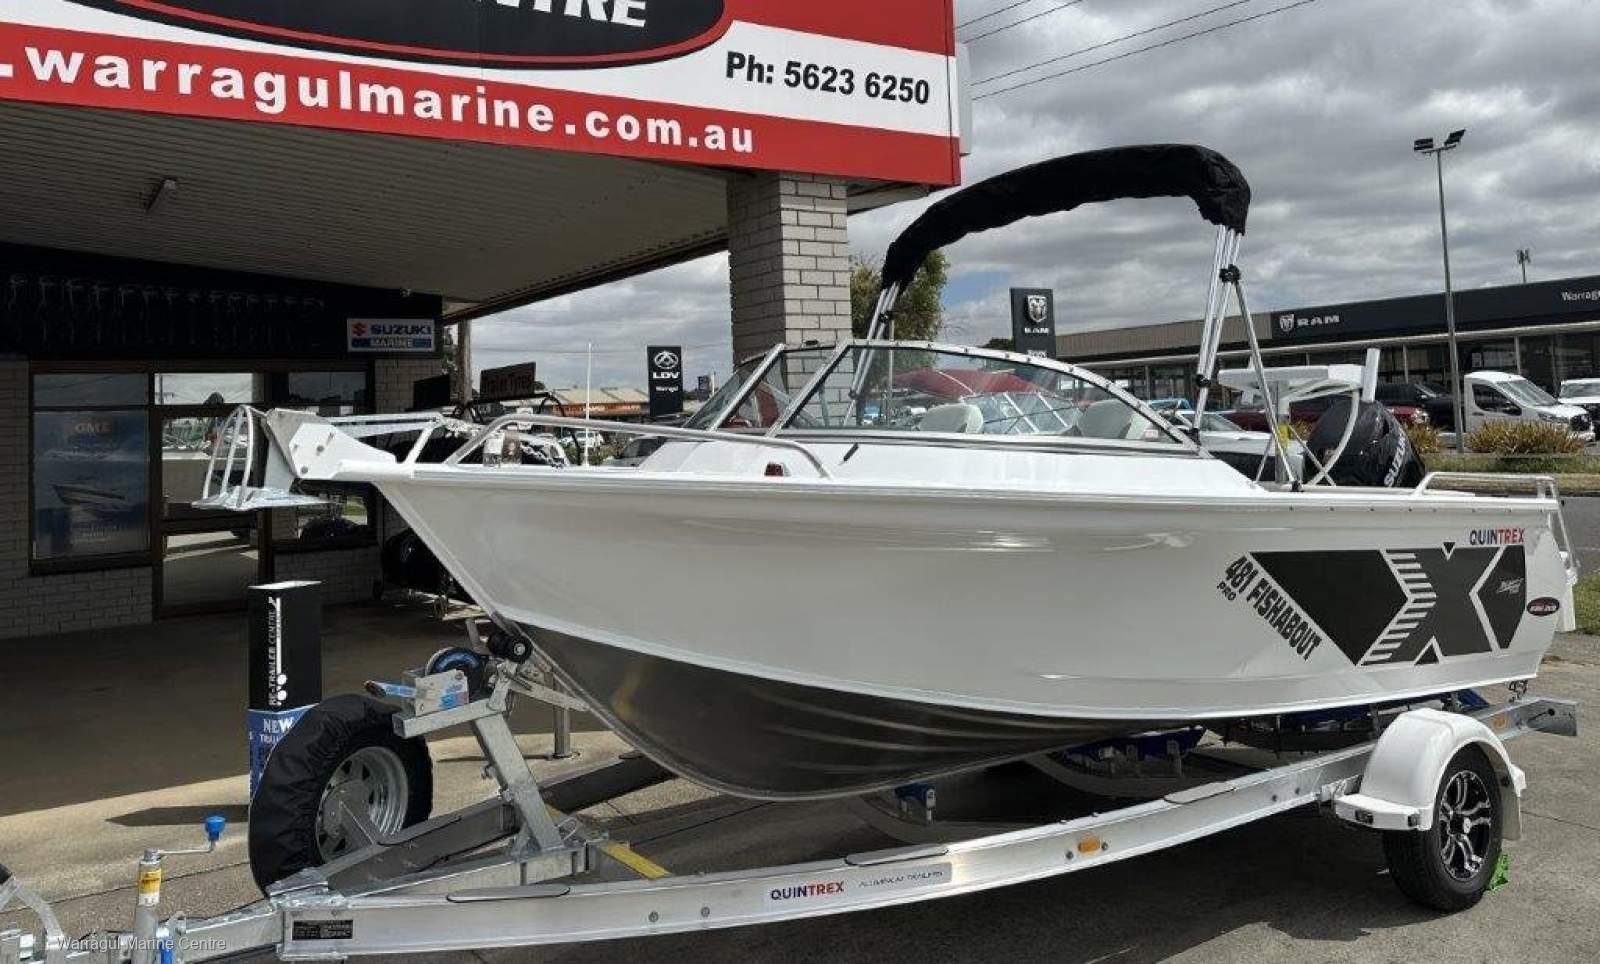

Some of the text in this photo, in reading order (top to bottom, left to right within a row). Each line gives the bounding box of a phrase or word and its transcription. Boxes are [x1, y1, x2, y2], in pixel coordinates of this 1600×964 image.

[726, 51, 930, 104] Ph: 5623 6250
[1560, 290, 1600, 302] Warrag
[370, 324, 432, 335] SUZUKI
[1298, 314, 1340, 327] RAM
[1469, 528, 1525, 546] QUINTREX
[1216, 579, 1238, 602] PRO
[1222, 555, 1322, 661] 481 FISHABOUT
[263, 718, 295, 733] NEW
[770, 881, 845, 901] QUINTREX
